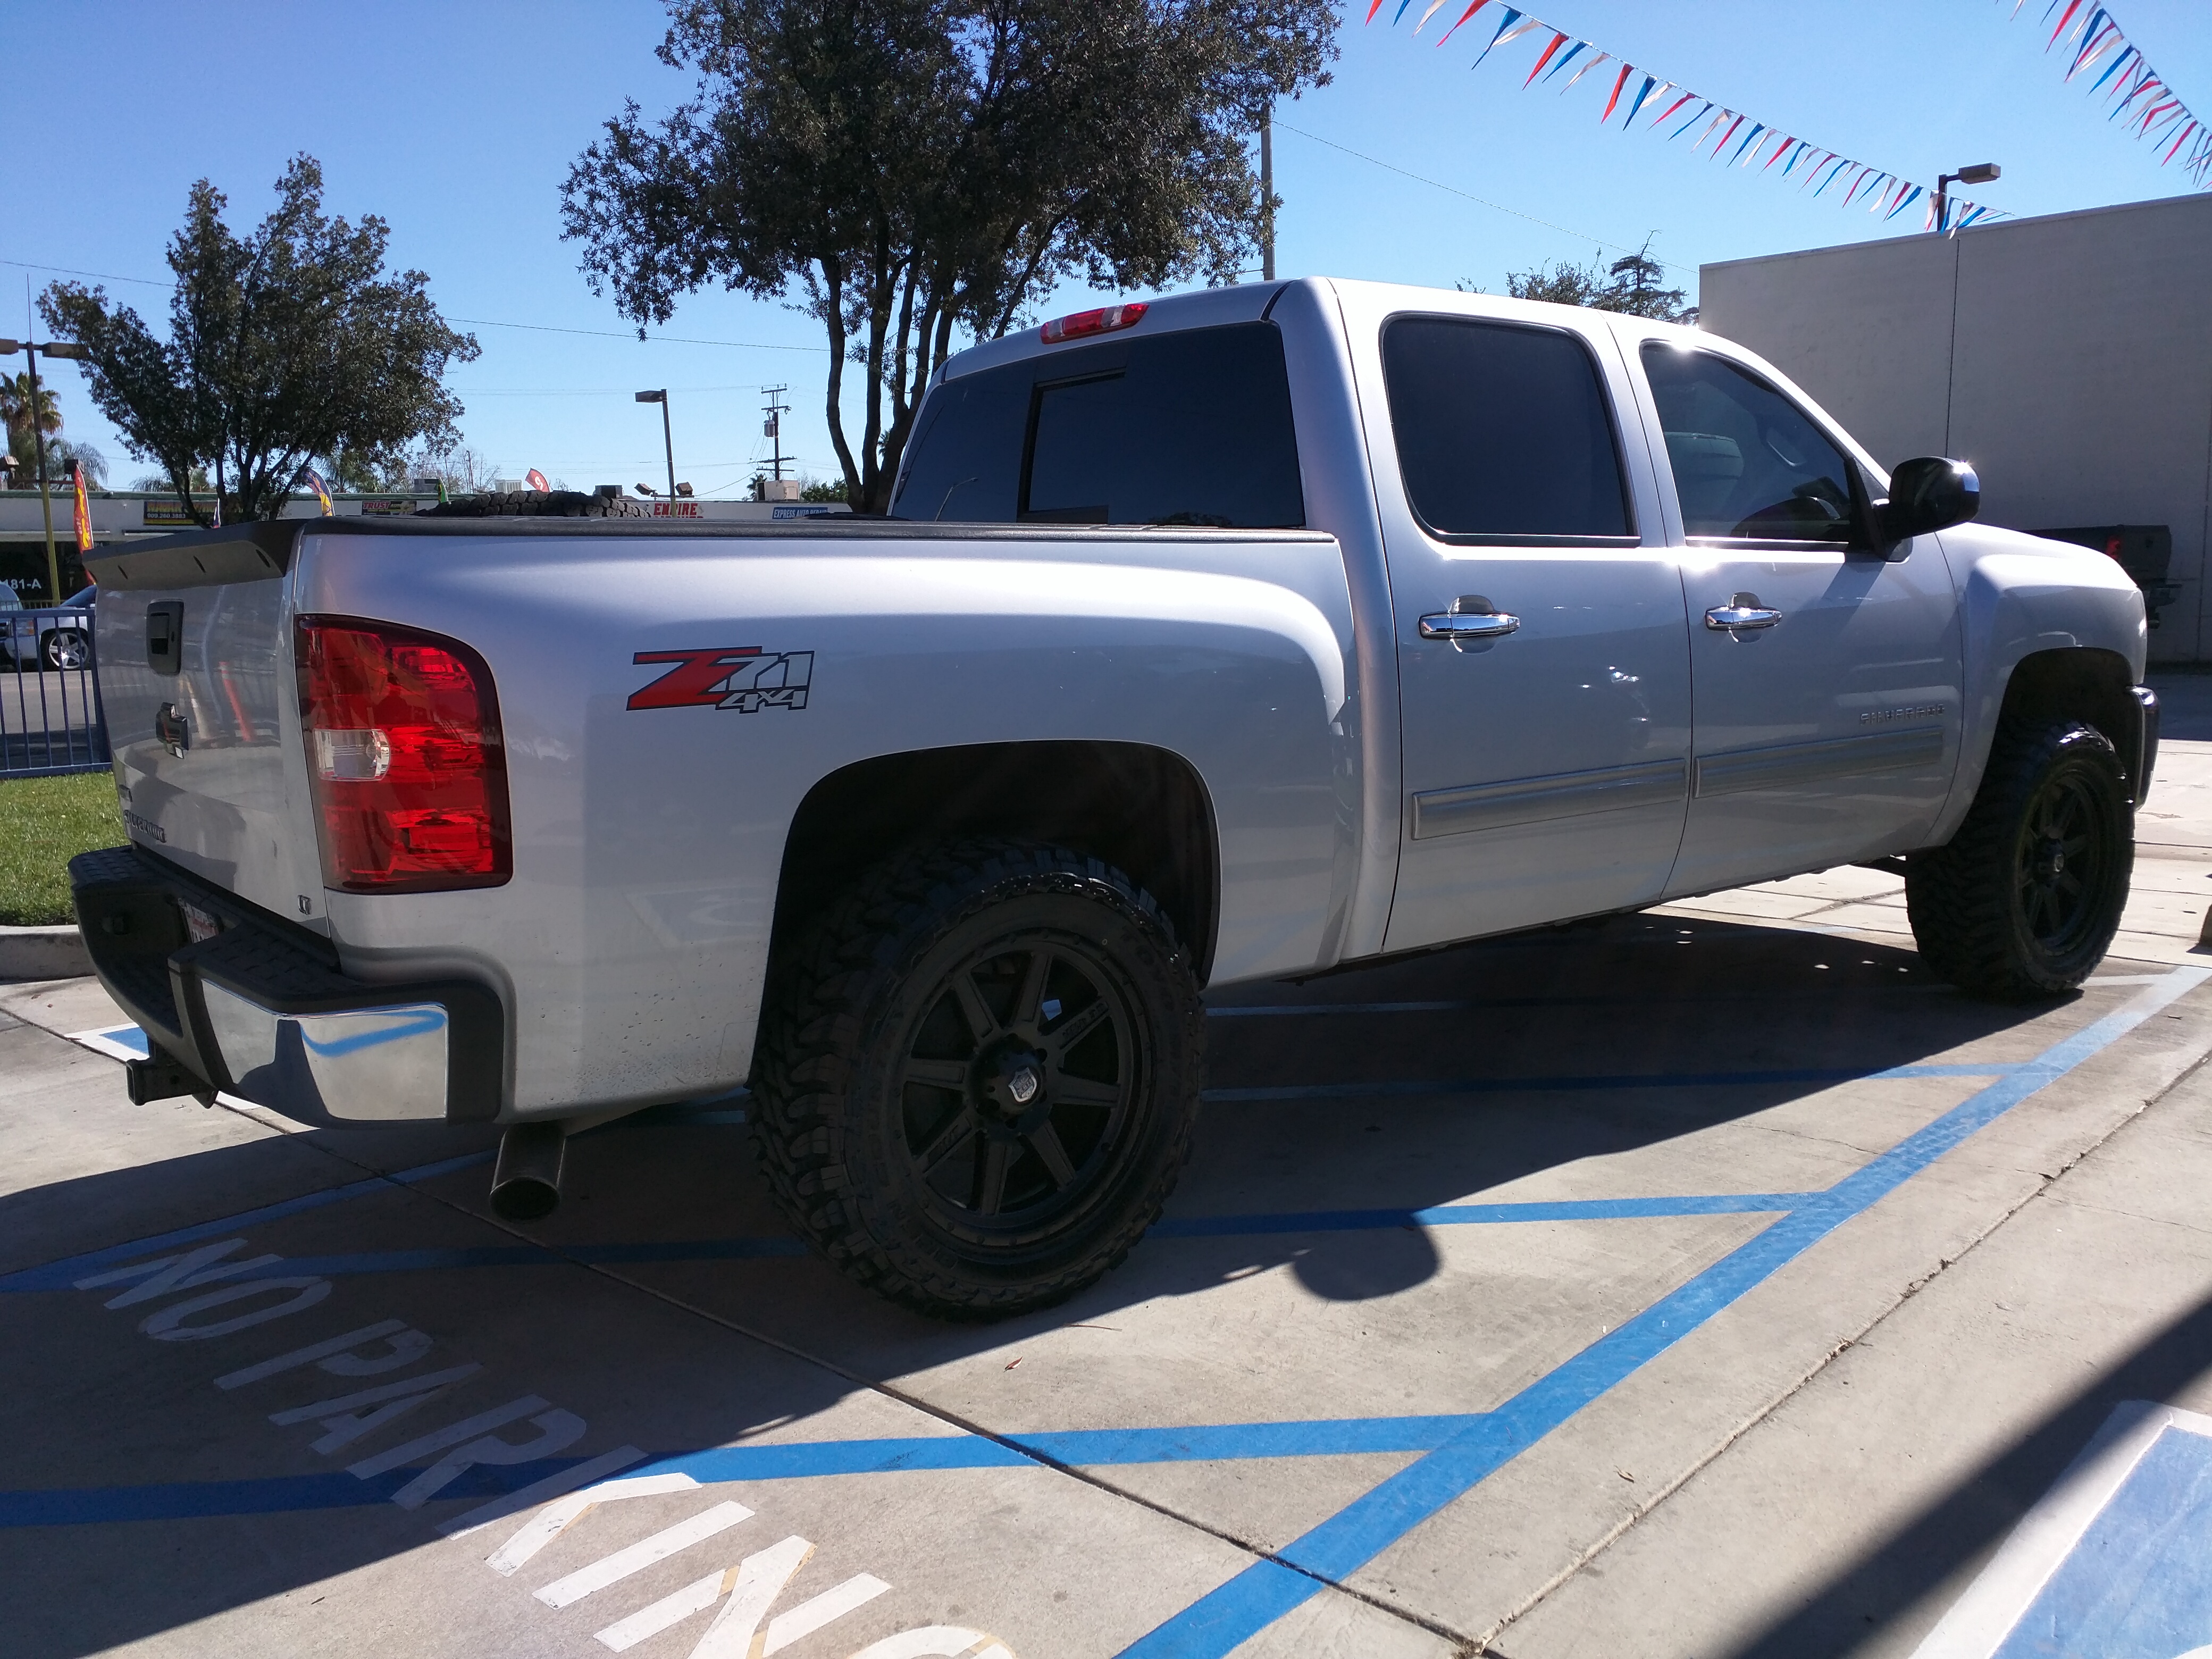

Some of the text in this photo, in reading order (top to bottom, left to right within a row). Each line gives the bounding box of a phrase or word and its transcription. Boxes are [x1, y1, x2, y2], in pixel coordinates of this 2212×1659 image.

[653, 502, 698, 516] EMIRE
[773, 509, 795, 518] EXPRESS
[626, 646, 815, 711] Z71
[73, 1237, 332, 1342] NO
[213, 1318, 1016, 1659] PARKIN
